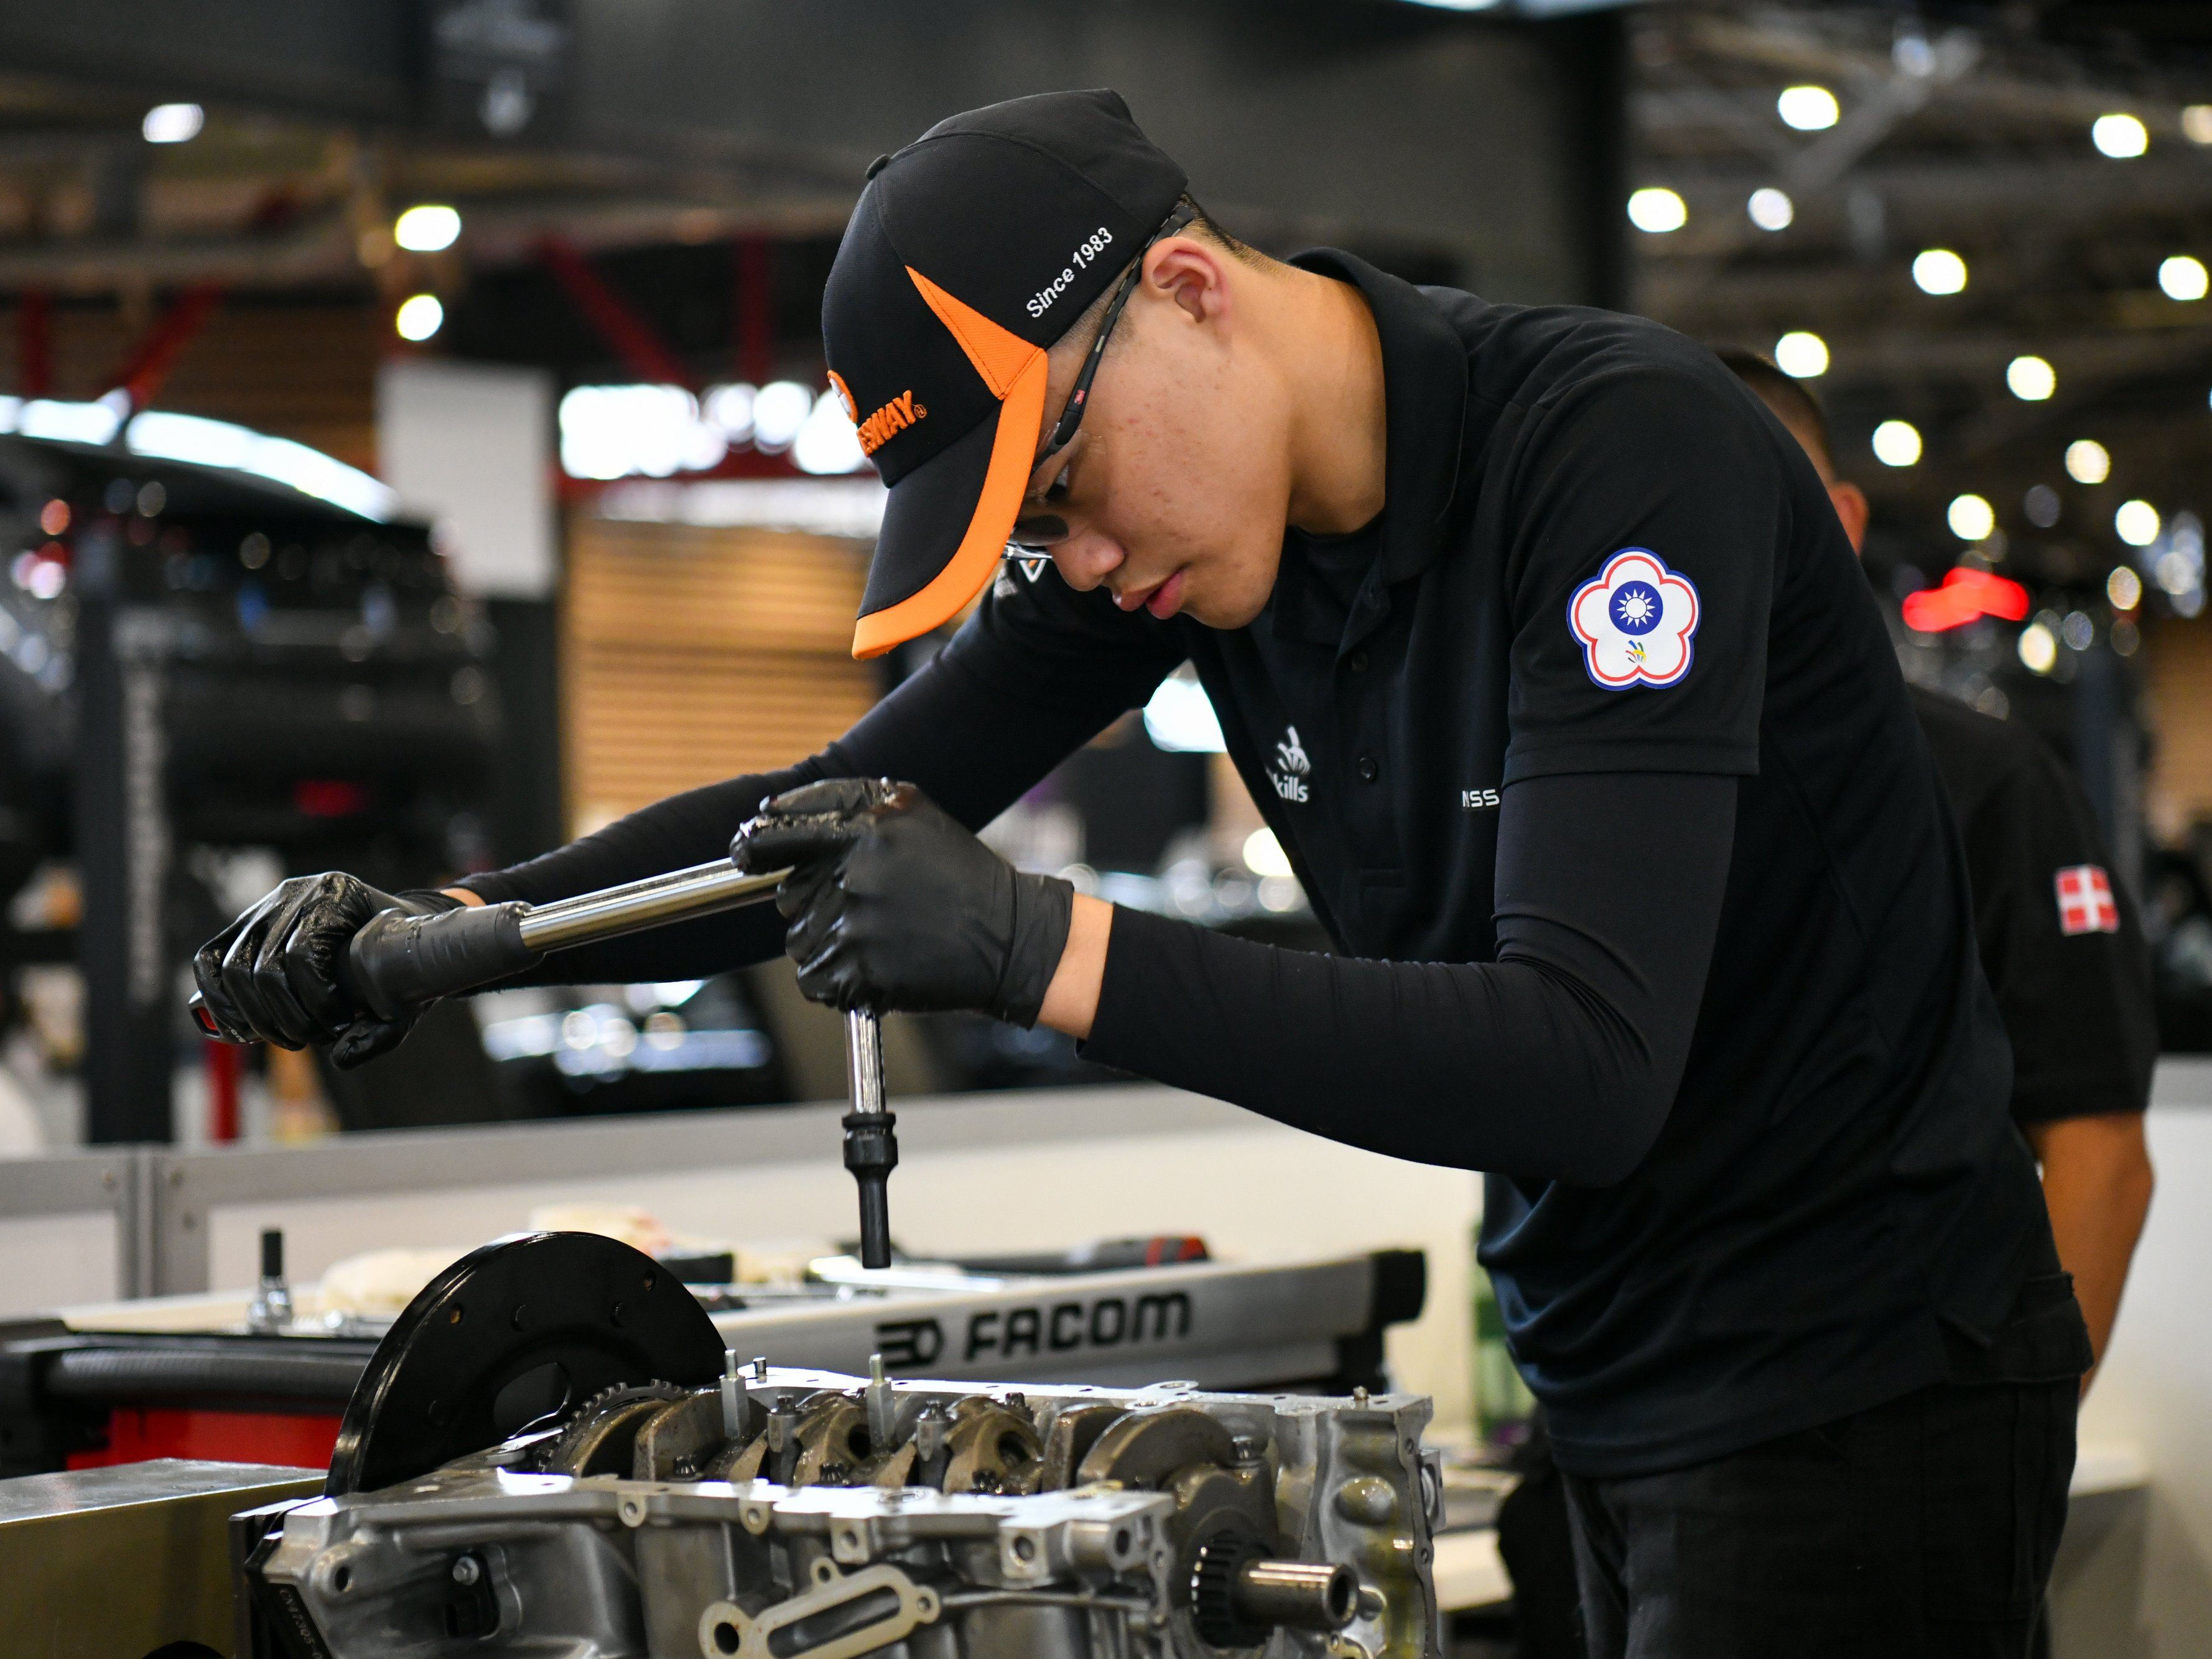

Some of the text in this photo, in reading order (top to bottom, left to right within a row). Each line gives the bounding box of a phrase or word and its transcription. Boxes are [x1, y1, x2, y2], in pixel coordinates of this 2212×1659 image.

[1026, 227, 1113, 317] Since 1983
[1265, 766, 1309, 802] kills
[964, 1291, 1189, 1360] FACOM
